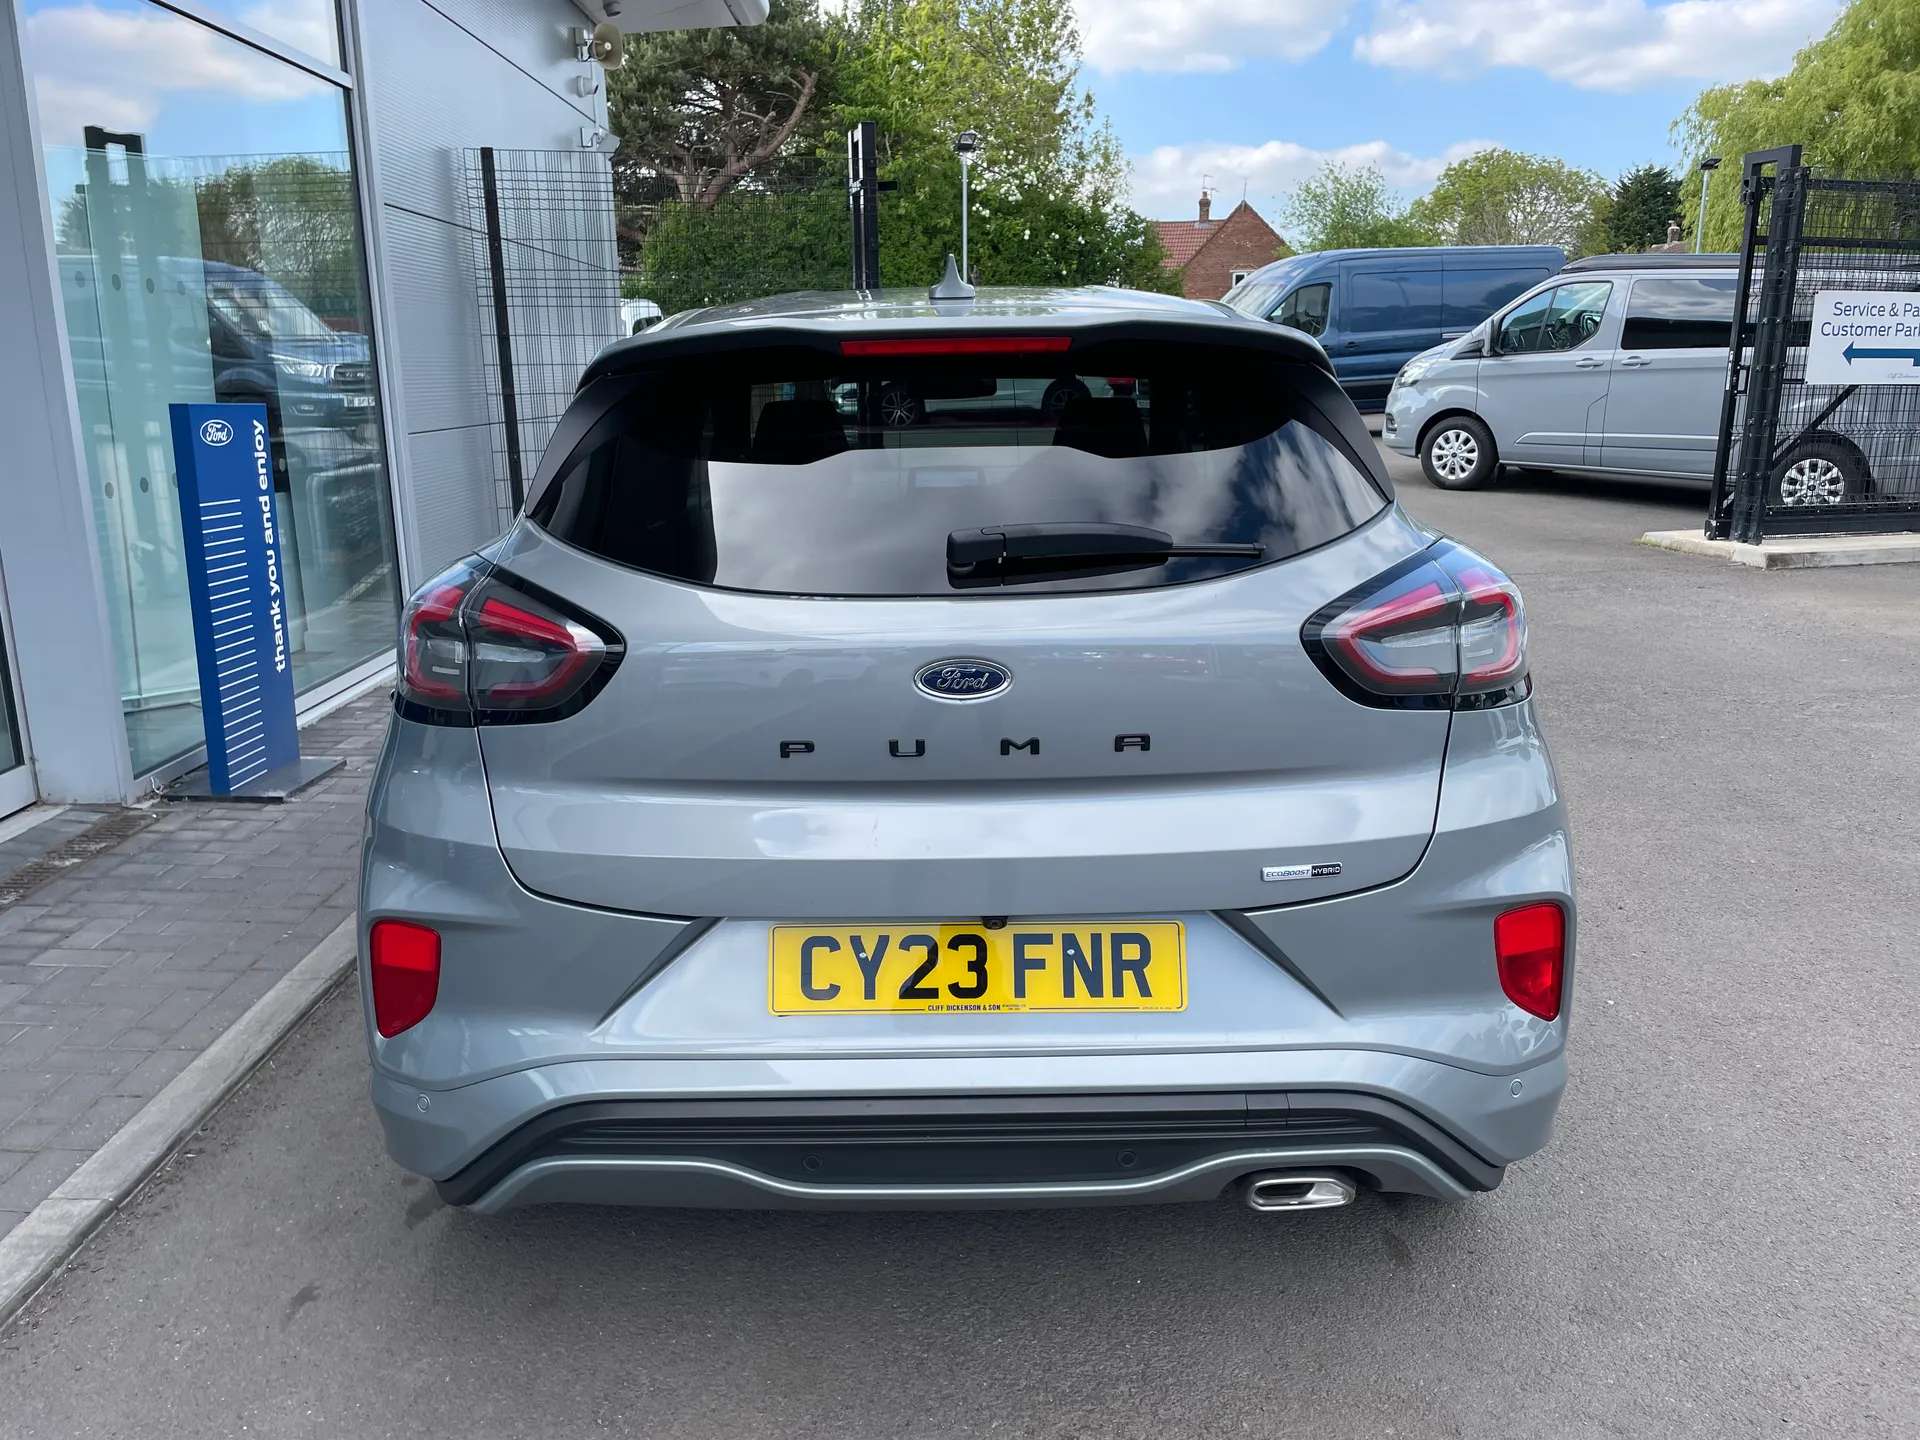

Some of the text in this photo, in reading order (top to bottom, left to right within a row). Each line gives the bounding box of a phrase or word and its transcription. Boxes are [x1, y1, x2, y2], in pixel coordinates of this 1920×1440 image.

[1833, 302, 1885, 317] Service
[1889, 302, 1898, 317] &
[1821, 322, 1920, 337] Customer Par
[253, 419, 286, 673] thank you and enjoy
[937, 667, 990, 689] Ford
[780, 733, 1151, 758] PUMA
[1312, 866, 1341, 875] HYBRID
[800, 932, 1153, 1001] CY23 FNR
